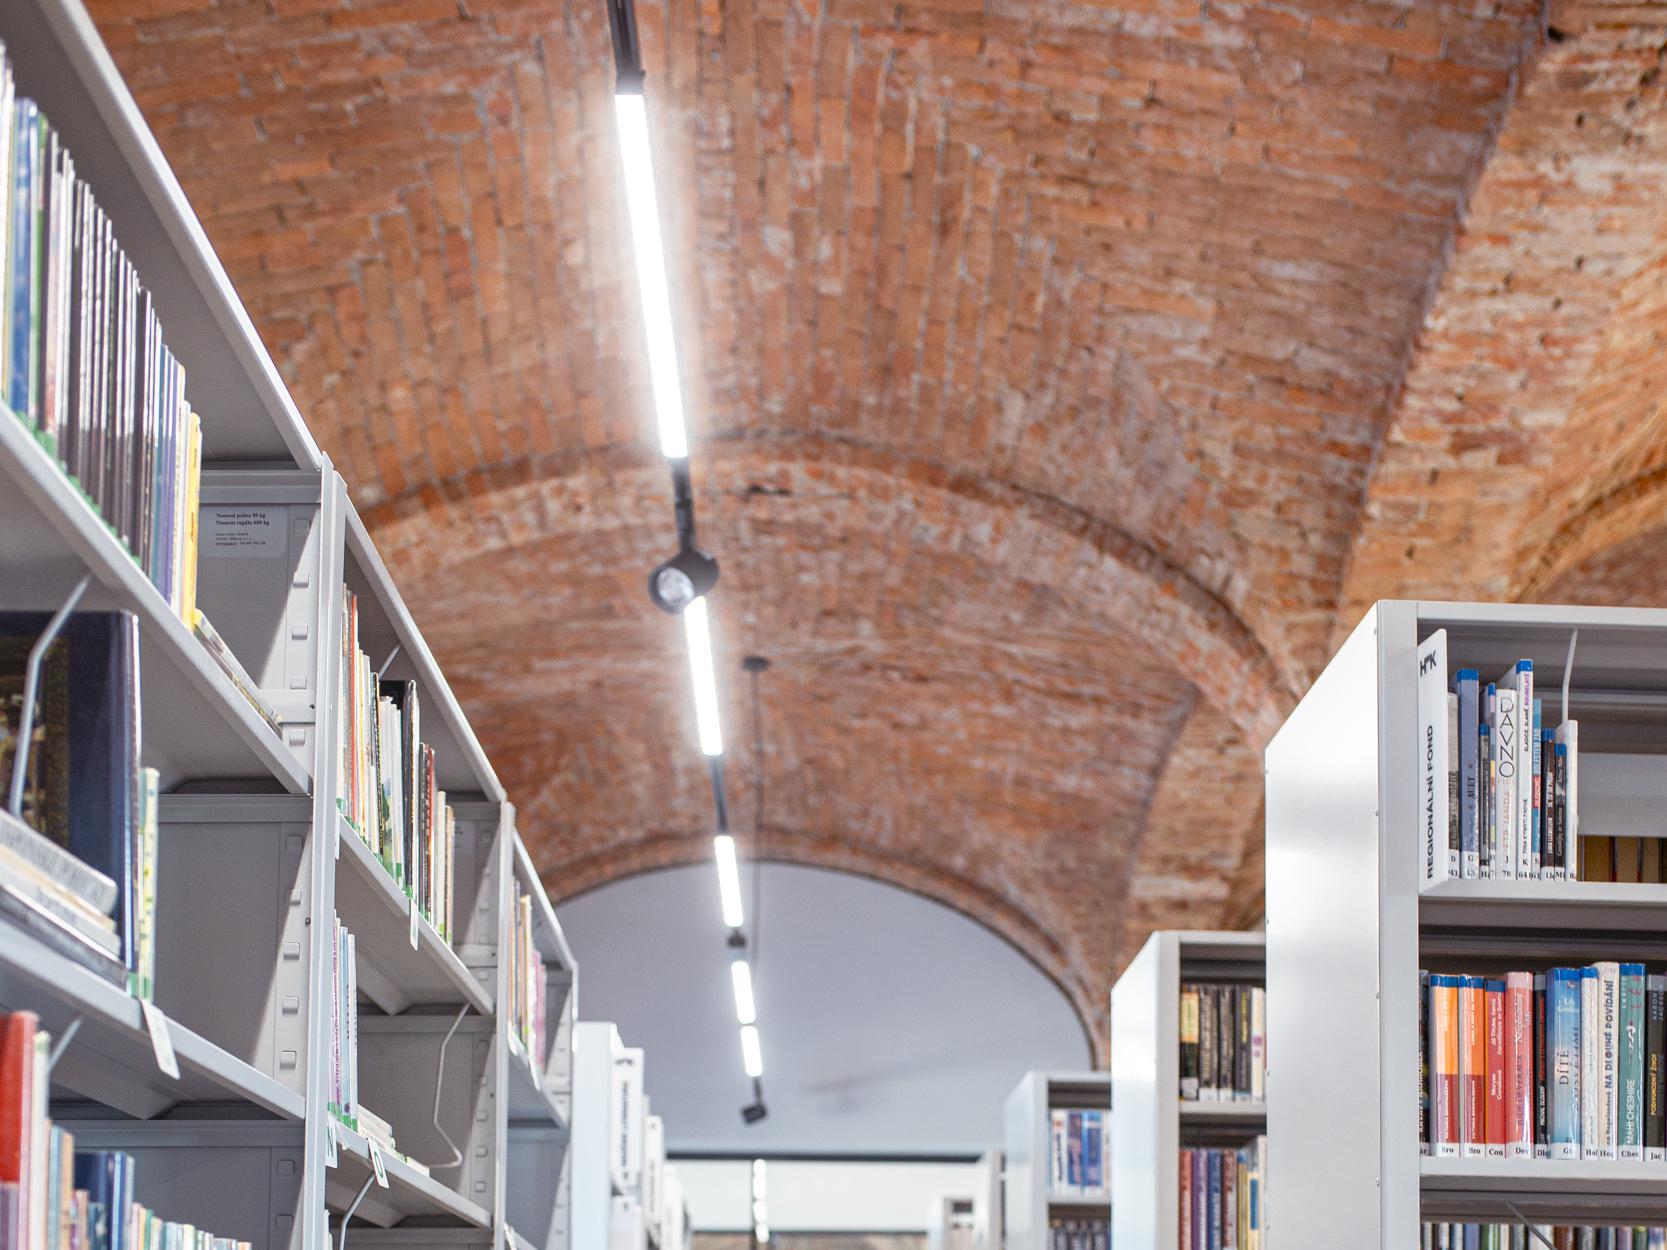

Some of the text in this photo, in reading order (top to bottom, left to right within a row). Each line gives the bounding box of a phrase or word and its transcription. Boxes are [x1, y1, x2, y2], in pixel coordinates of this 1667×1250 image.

[1426, 725, 1434, 879] REGIONÁLNÍ FOND
[1604, 980, 1613, 1028] POVÍDÁNÍ
[1556, 1050, 1569, 1085] DÍTĚ
[1604, 1074, 1613, 1088] NA
[1488, 1148, 1503, 1156] Con
[1649, 1152, 1662, 1160] Jac
